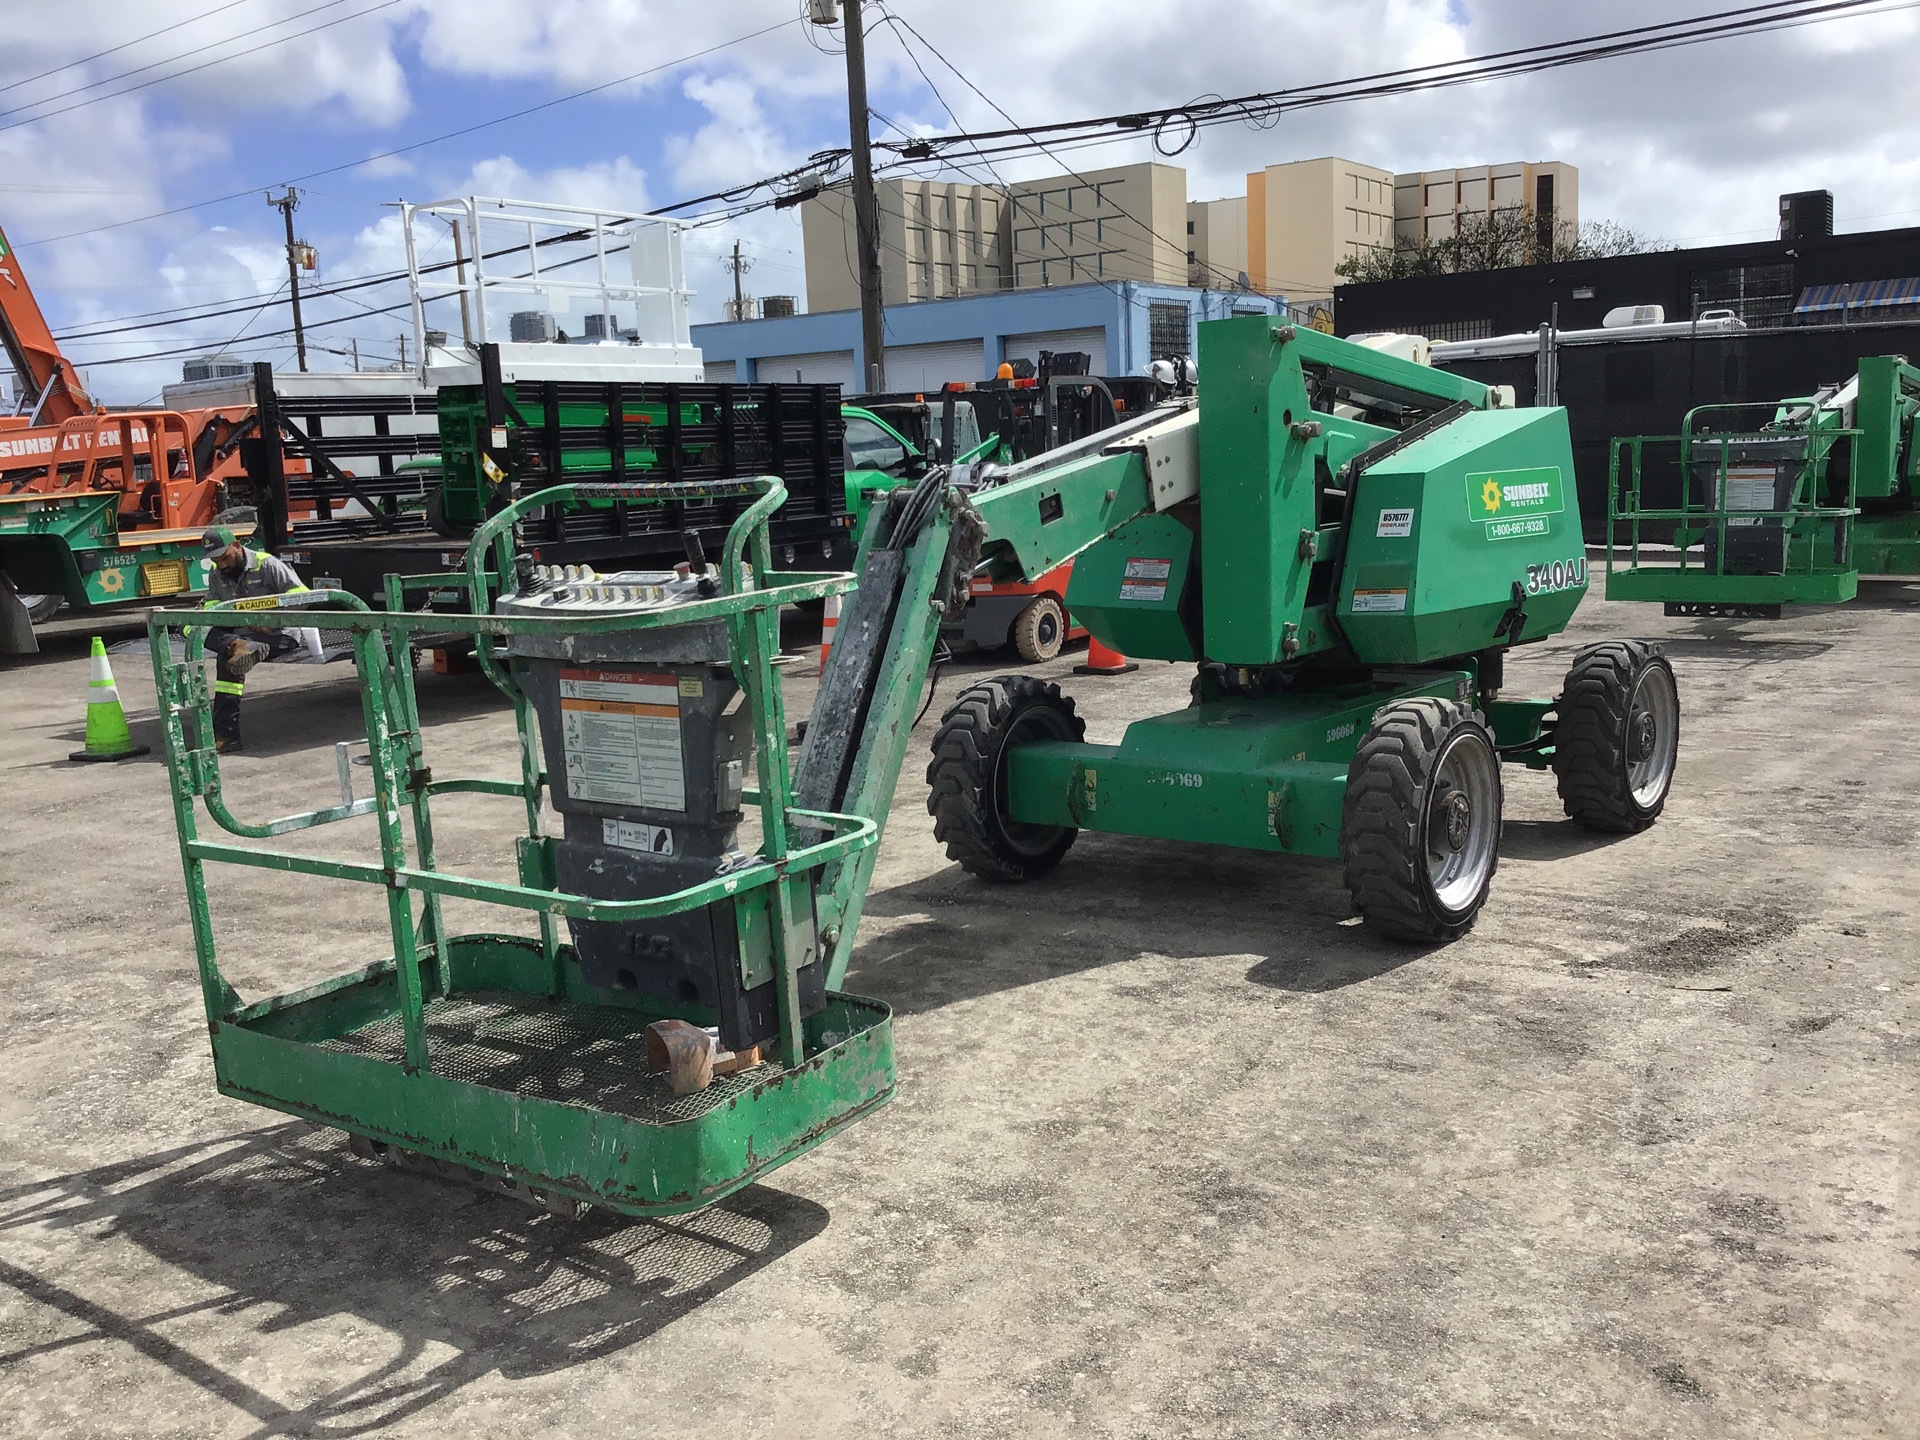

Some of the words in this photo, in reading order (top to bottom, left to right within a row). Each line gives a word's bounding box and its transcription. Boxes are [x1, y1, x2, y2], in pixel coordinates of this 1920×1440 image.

[1503, 482, 1549, 502] SUNBELT
[1511, 498, 1544, 507] RENTALS
[1491, 520, 1544, 536] 1-800-667-9328
[103, 554, 136, 567] 576525
[1526, 557, 1586, 595] 340AJ
[245, 599, 277, 609] CAUTION
[604, 673, 632, 681] DANGER
